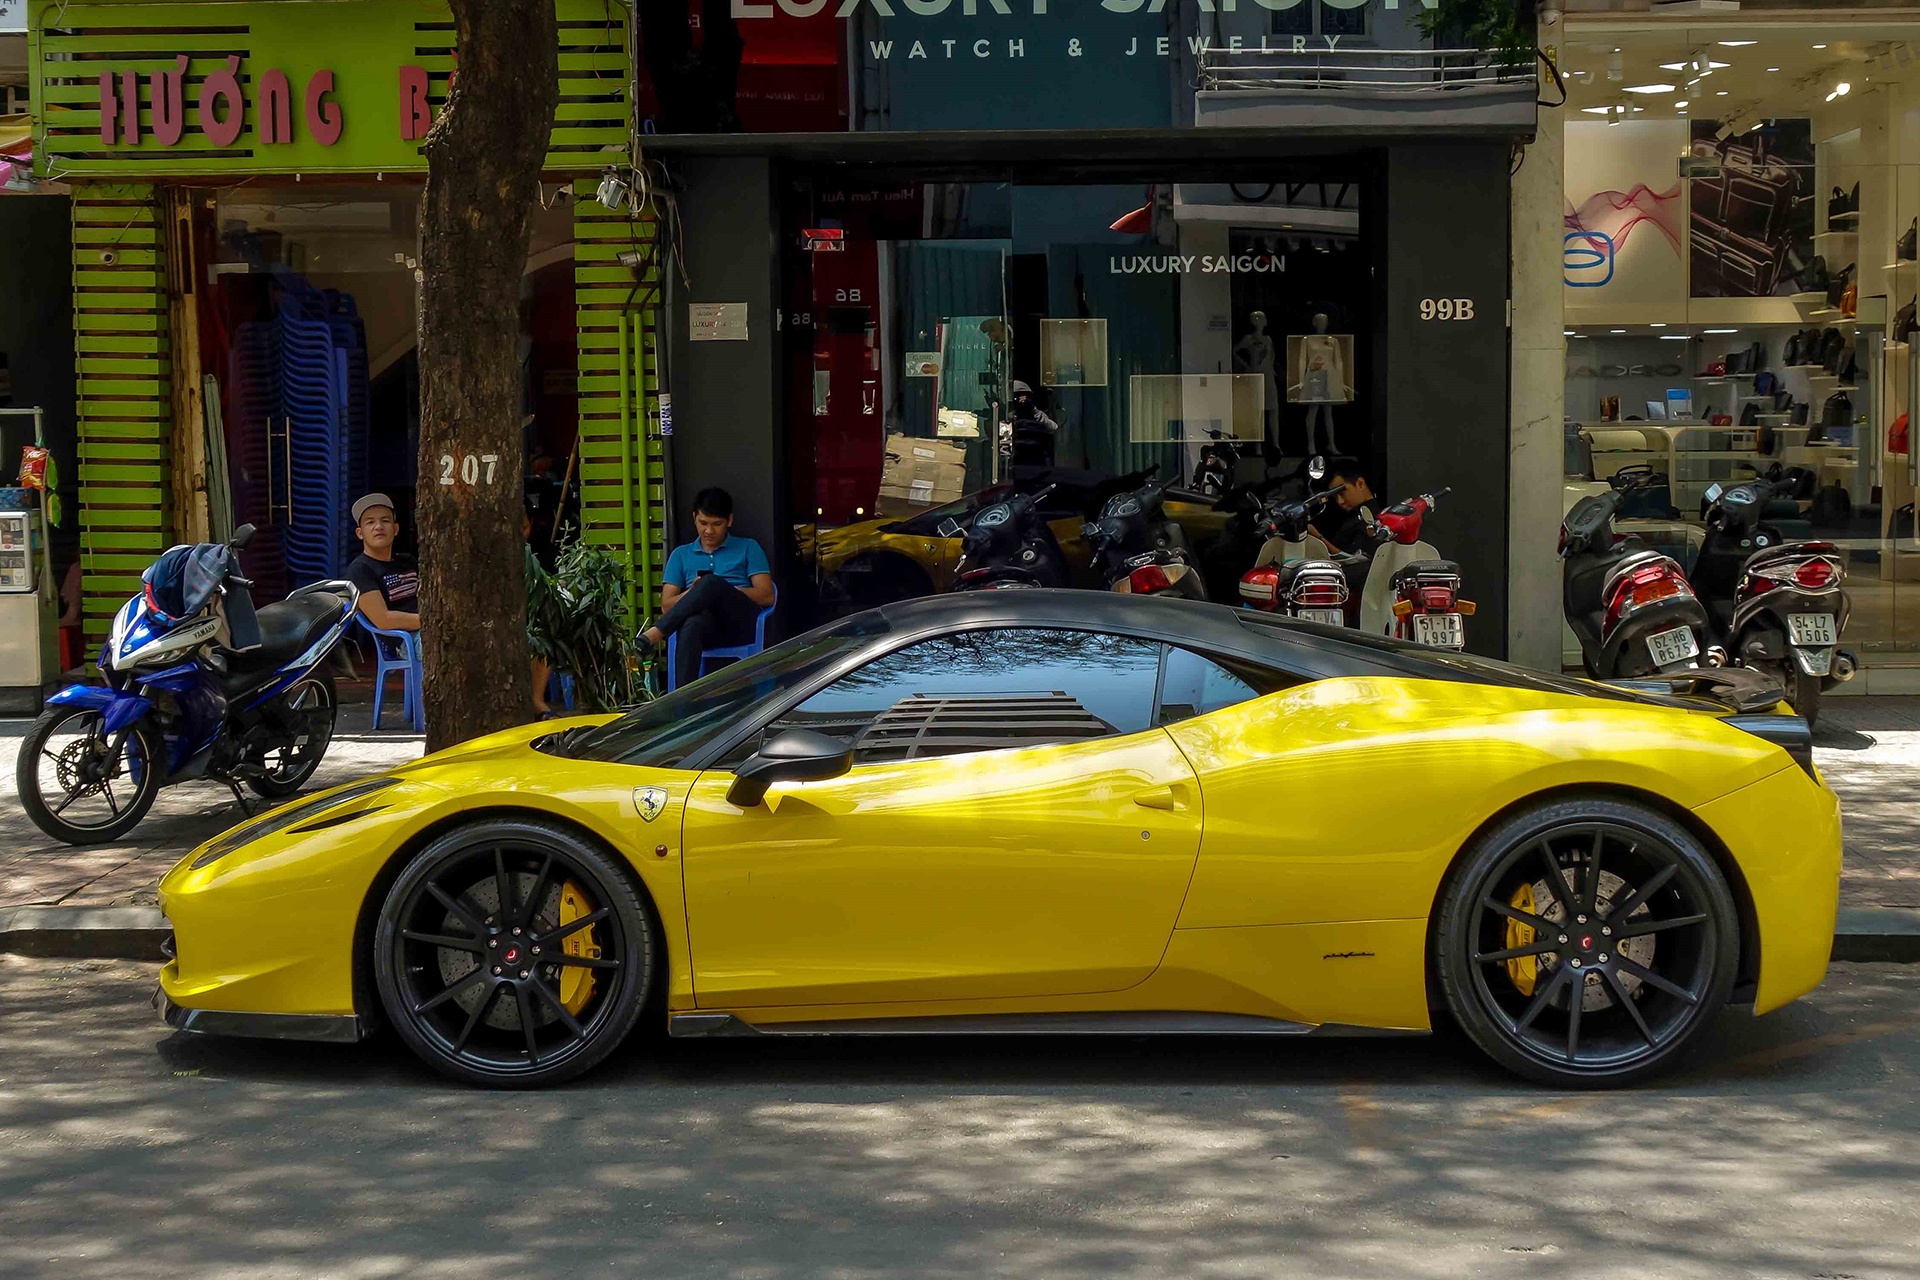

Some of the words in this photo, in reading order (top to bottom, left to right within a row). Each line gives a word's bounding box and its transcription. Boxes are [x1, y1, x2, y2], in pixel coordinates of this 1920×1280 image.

[869, 38, 1025, 59] WATCH
[1067, 38, 1082, 57] &
[1125, 34, 1342, 56] JEWELRY
[1110, 255, 1196, 274] LUXURY
[1201, 254, 1286, 273] SAIGON
[1419, 298, 1475, 321] 99B
[440, 454, 499, 485] 207
[192, 624, 216, 639] YAMAHA
[1795, 616, 1826, 629] 54-L7
[1423, 631, 1455, 645] 4997
[1653, 630, 1687, 649] 62-H6
[1797, 629, 1830, 642] 1506
